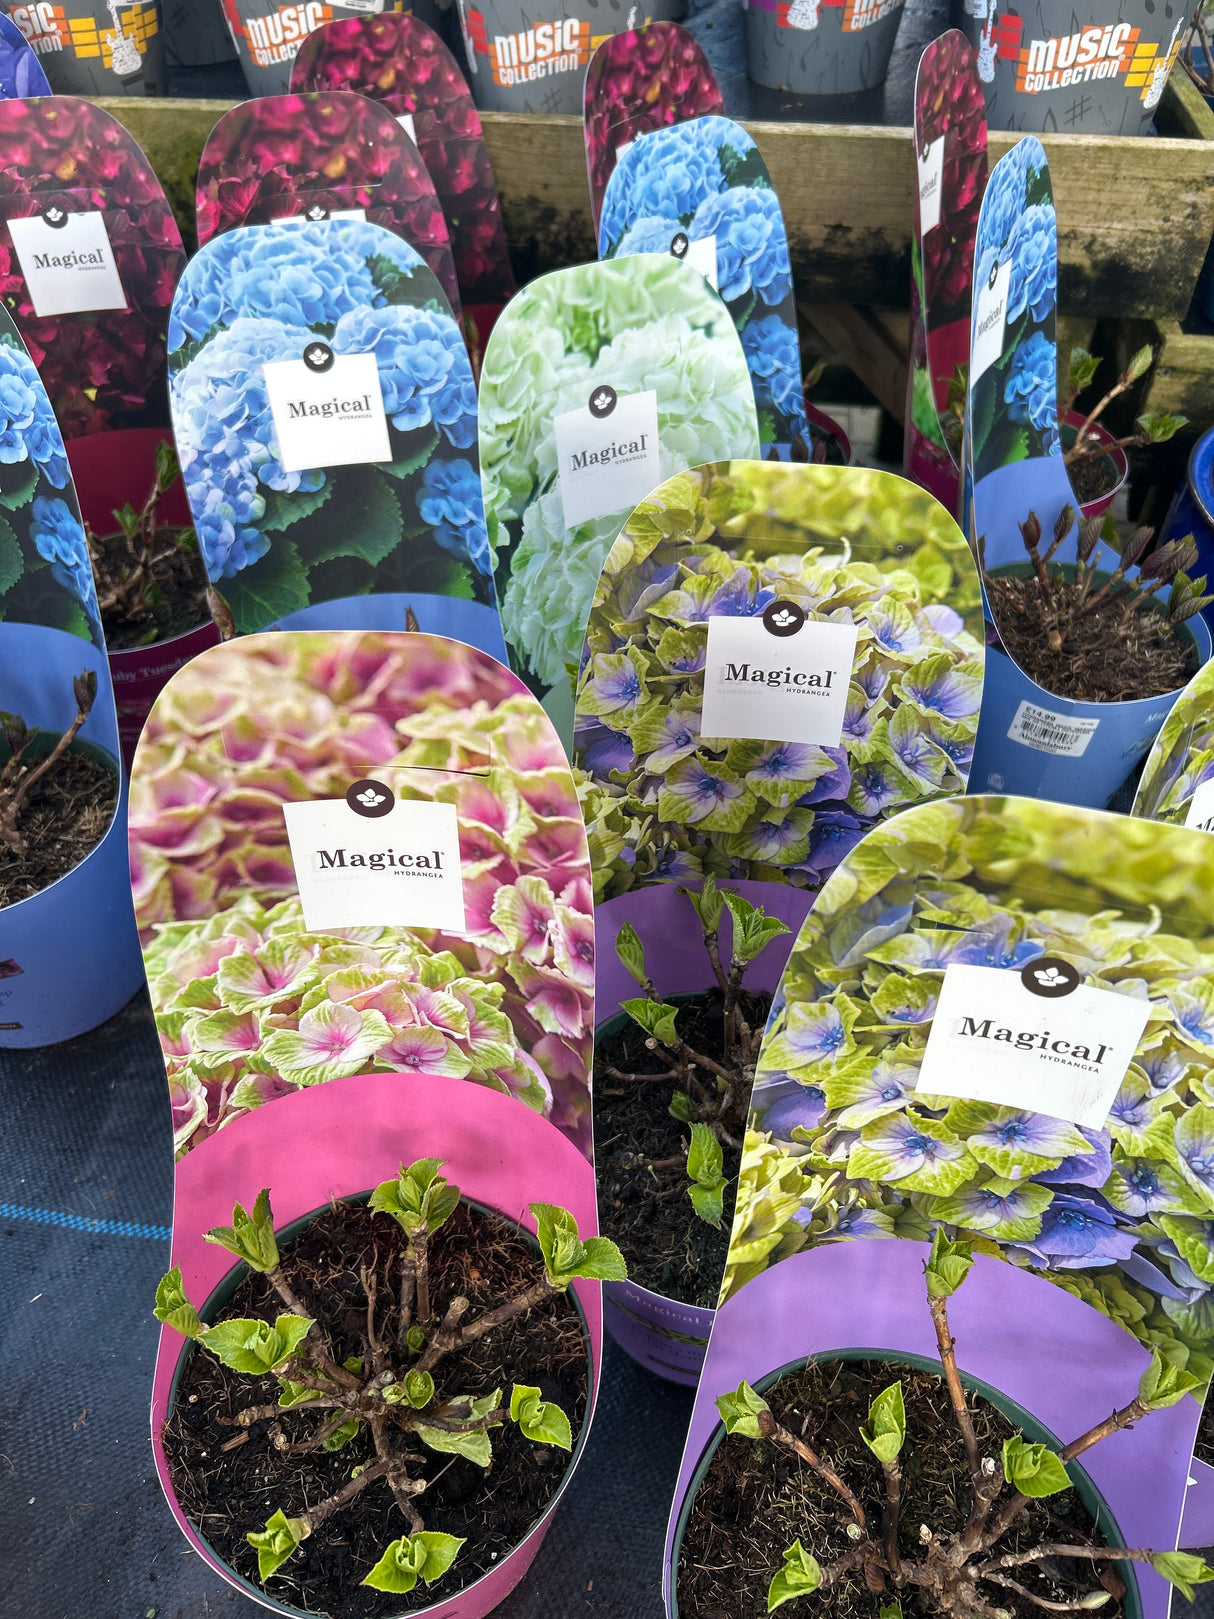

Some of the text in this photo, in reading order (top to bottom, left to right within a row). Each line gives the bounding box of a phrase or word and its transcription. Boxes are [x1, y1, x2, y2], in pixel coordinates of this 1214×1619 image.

[32, 248, 105, 270] Magical
[287, 395, 372, 419] Magical
[571, 434, 647, 471] Magical
[725, 663, 833, 688] Magical
[786, 687, 831, 697] HYDRANGEA
[316, 848, 444, 871] Magical
[394, 870, 444, 879] HYDRANGEA
[957, 1016, 1108, 1065] Magical
[1040, 1053, 1100, 1074] HYDRANGEA
